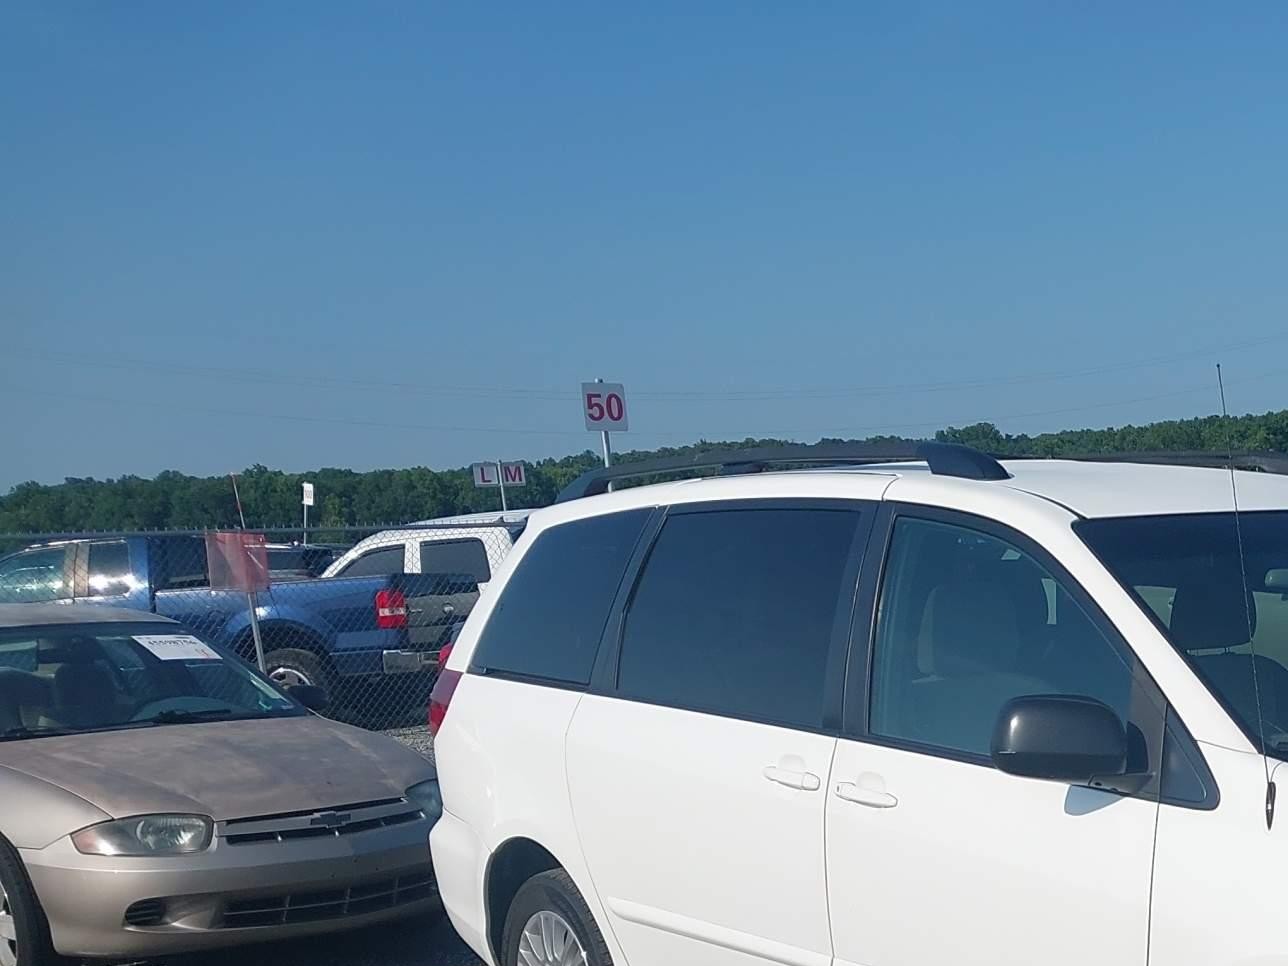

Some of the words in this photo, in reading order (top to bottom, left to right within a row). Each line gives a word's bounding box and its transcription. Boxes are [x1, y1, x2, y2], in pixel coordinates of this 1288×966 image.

[586, 393, 624, 421] 50
[480, 467, 492, 483] L
[503, 466, 523, 482] M
